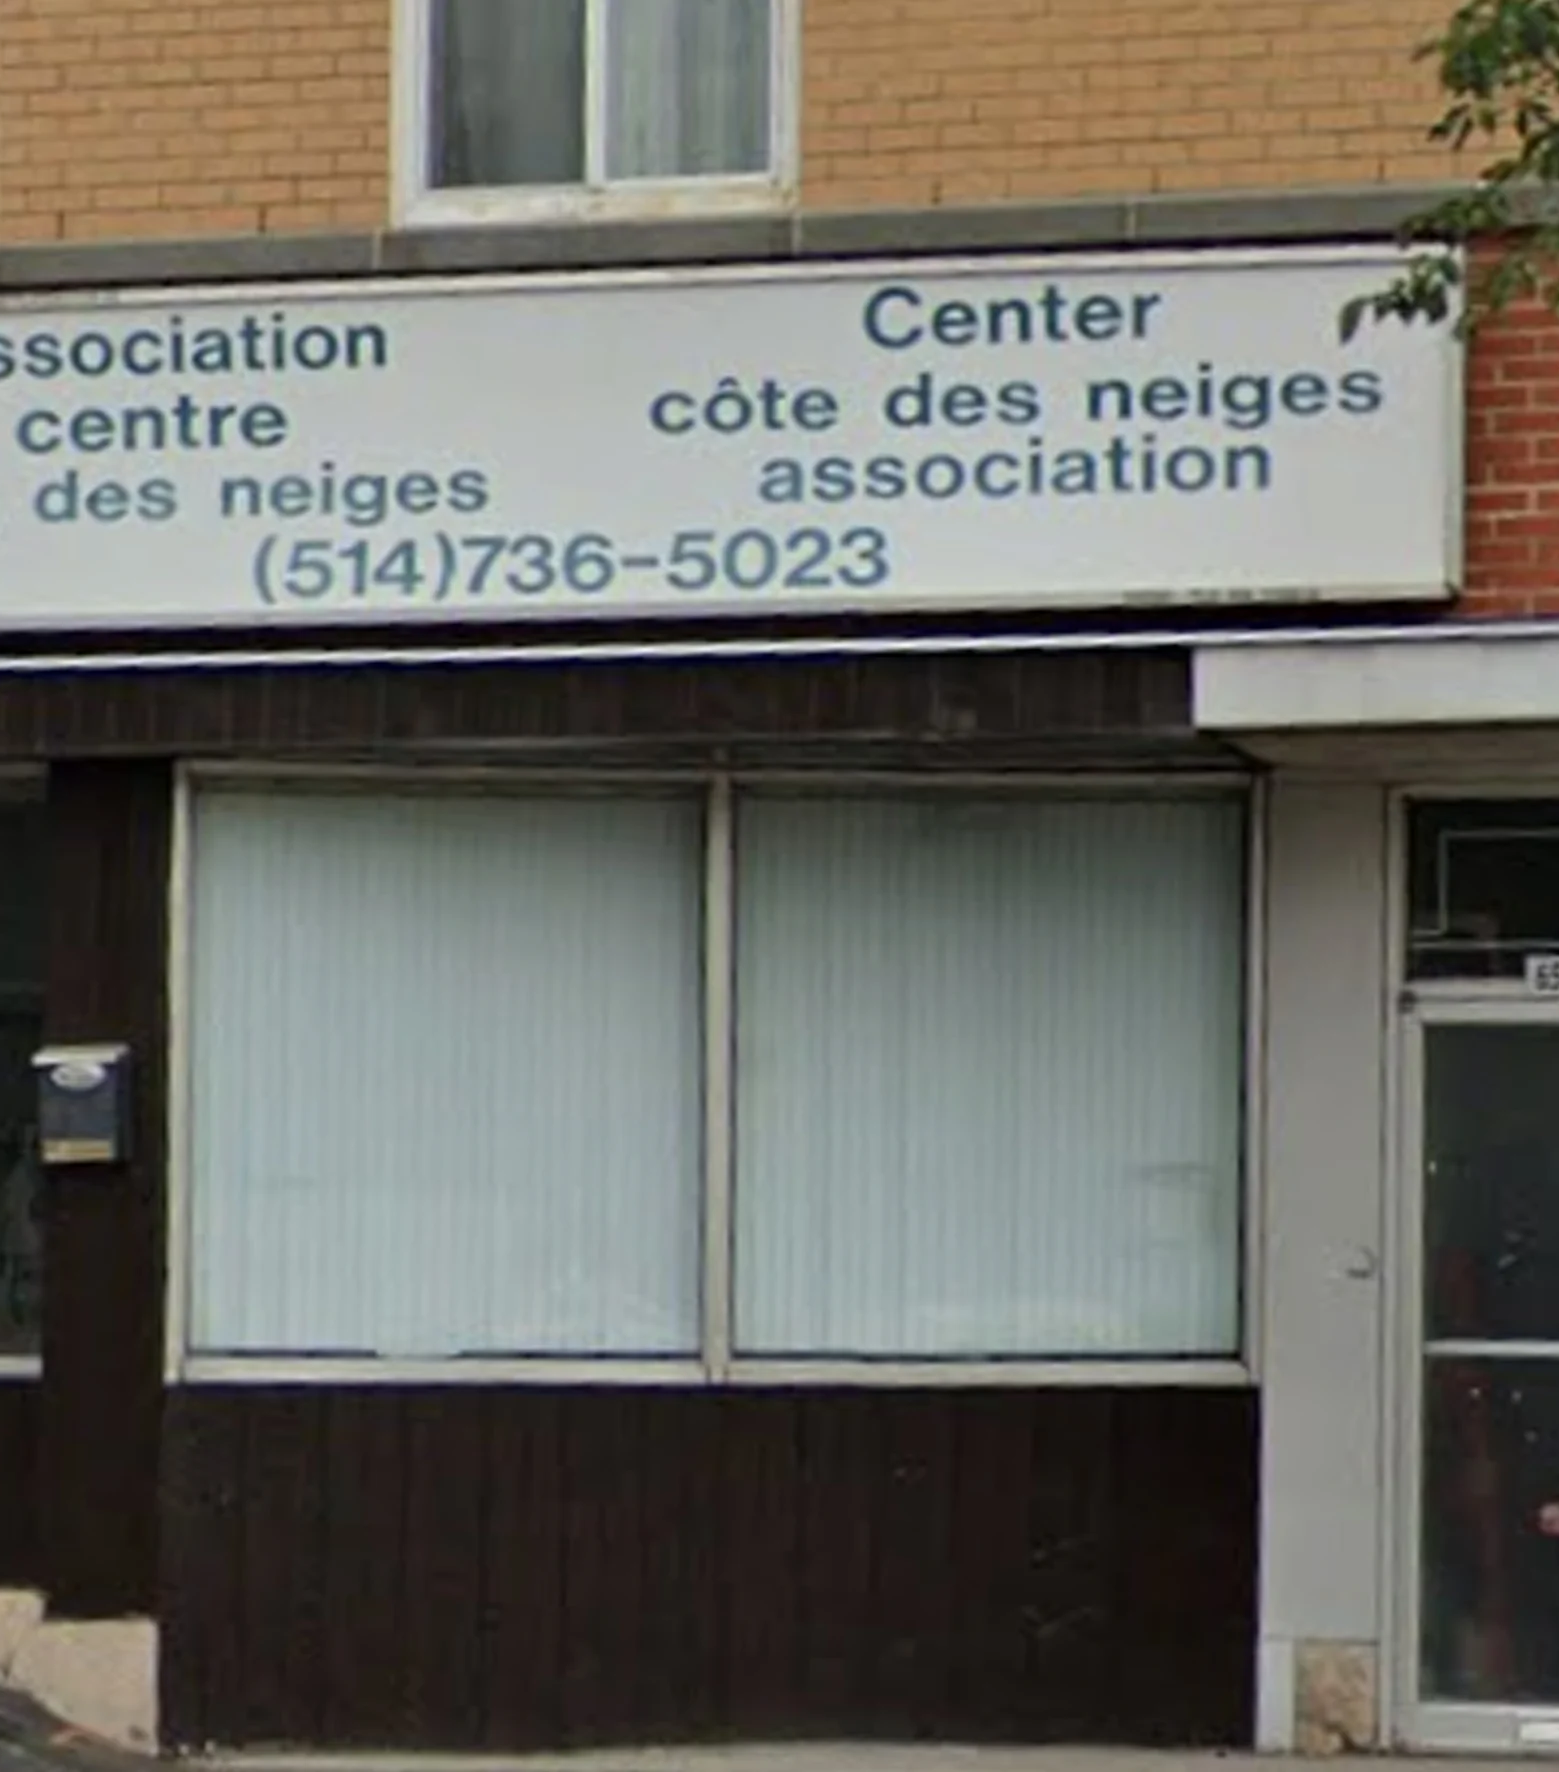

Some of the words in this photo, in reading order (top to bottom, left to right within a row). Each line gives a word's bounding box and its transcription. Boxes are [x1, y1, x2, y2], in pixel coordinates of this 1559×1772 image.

[861, 282, 1163, 352] Center
[14, 392, 289, 456] centre
[648, 375, 841, 436] côte
[882, 370, 1042, 430] des
[1085, 360, 1384, 432] neiges
[33, 468, 178, 524] des
[219, 460, 490, 528] neiges
[758, 434, 1272, 504] association
[252, 525, 890, 604] (514)736-5023
